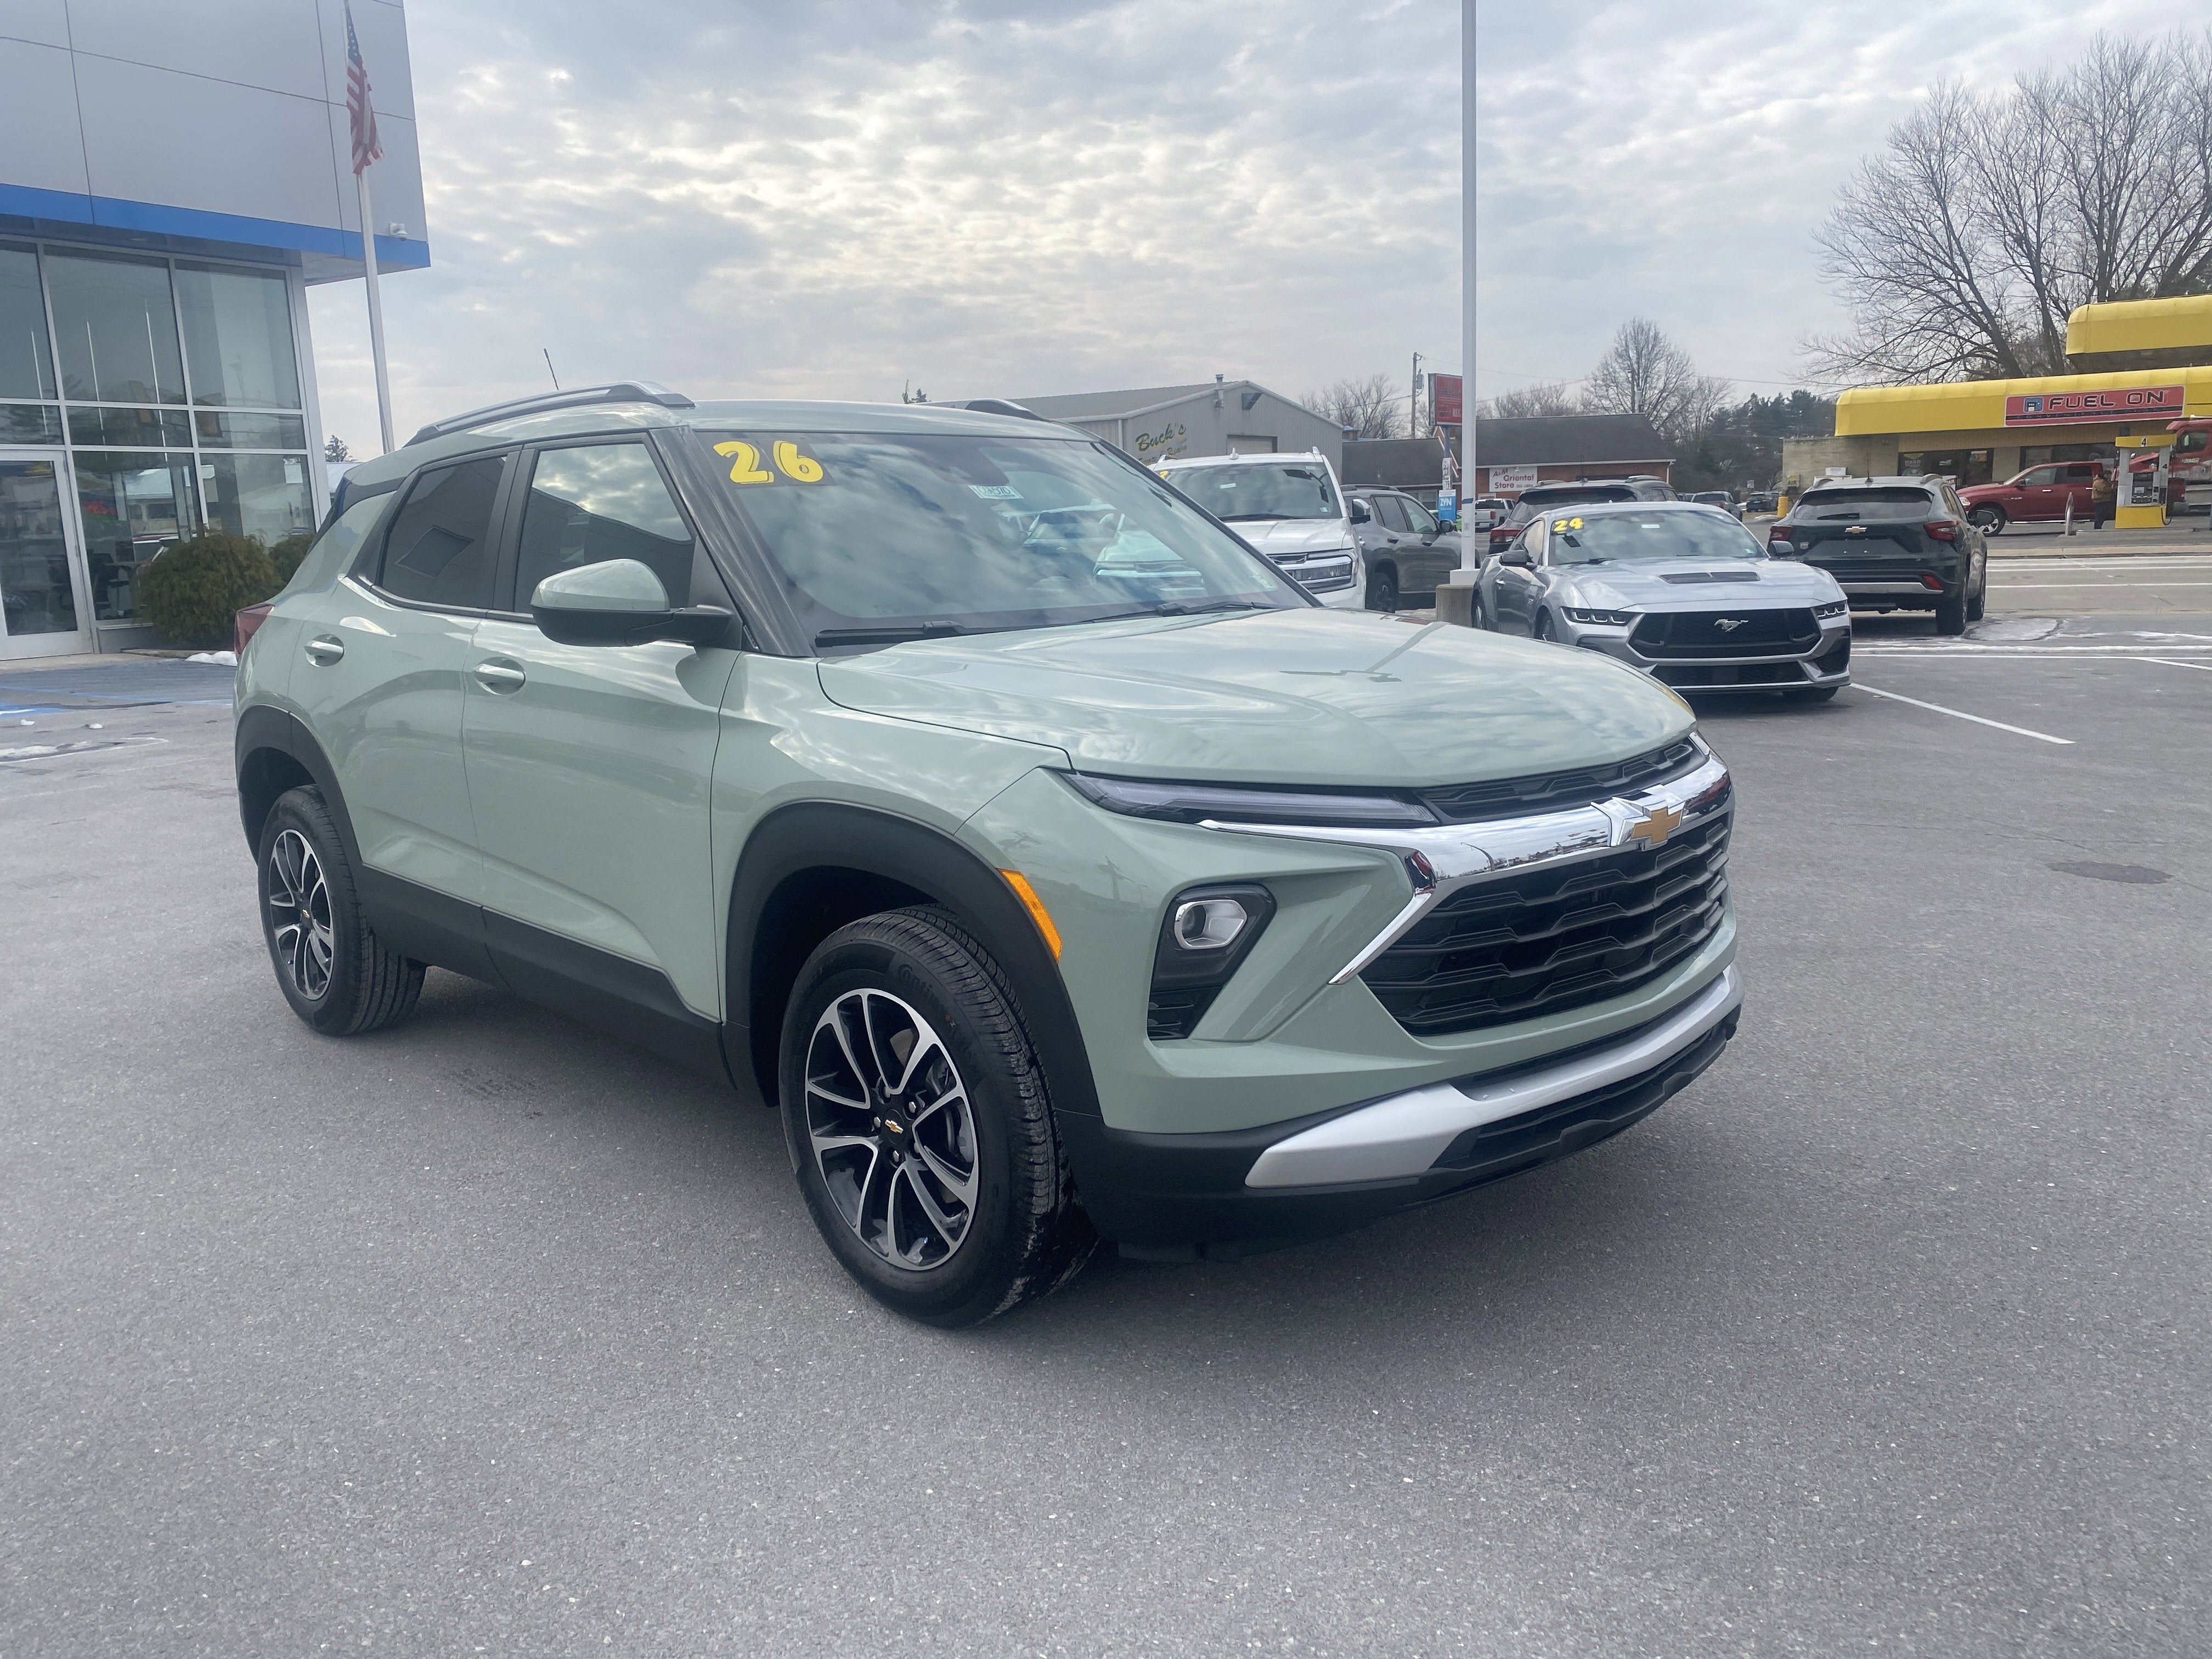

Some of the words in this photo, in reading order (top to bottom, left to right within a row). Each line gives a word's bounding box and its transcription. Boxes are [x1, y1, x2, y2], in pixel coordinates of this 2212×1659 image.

[2049, 394, 2114, 410] FUEL
[2127, 390, 2164, 404] ON
[2141, 438, 2147, 447] 4
[714, 441, 823, 484] 26
[1440, 498, 1452, 506] ZYN
[1554, 517, 1584, 532] 24
